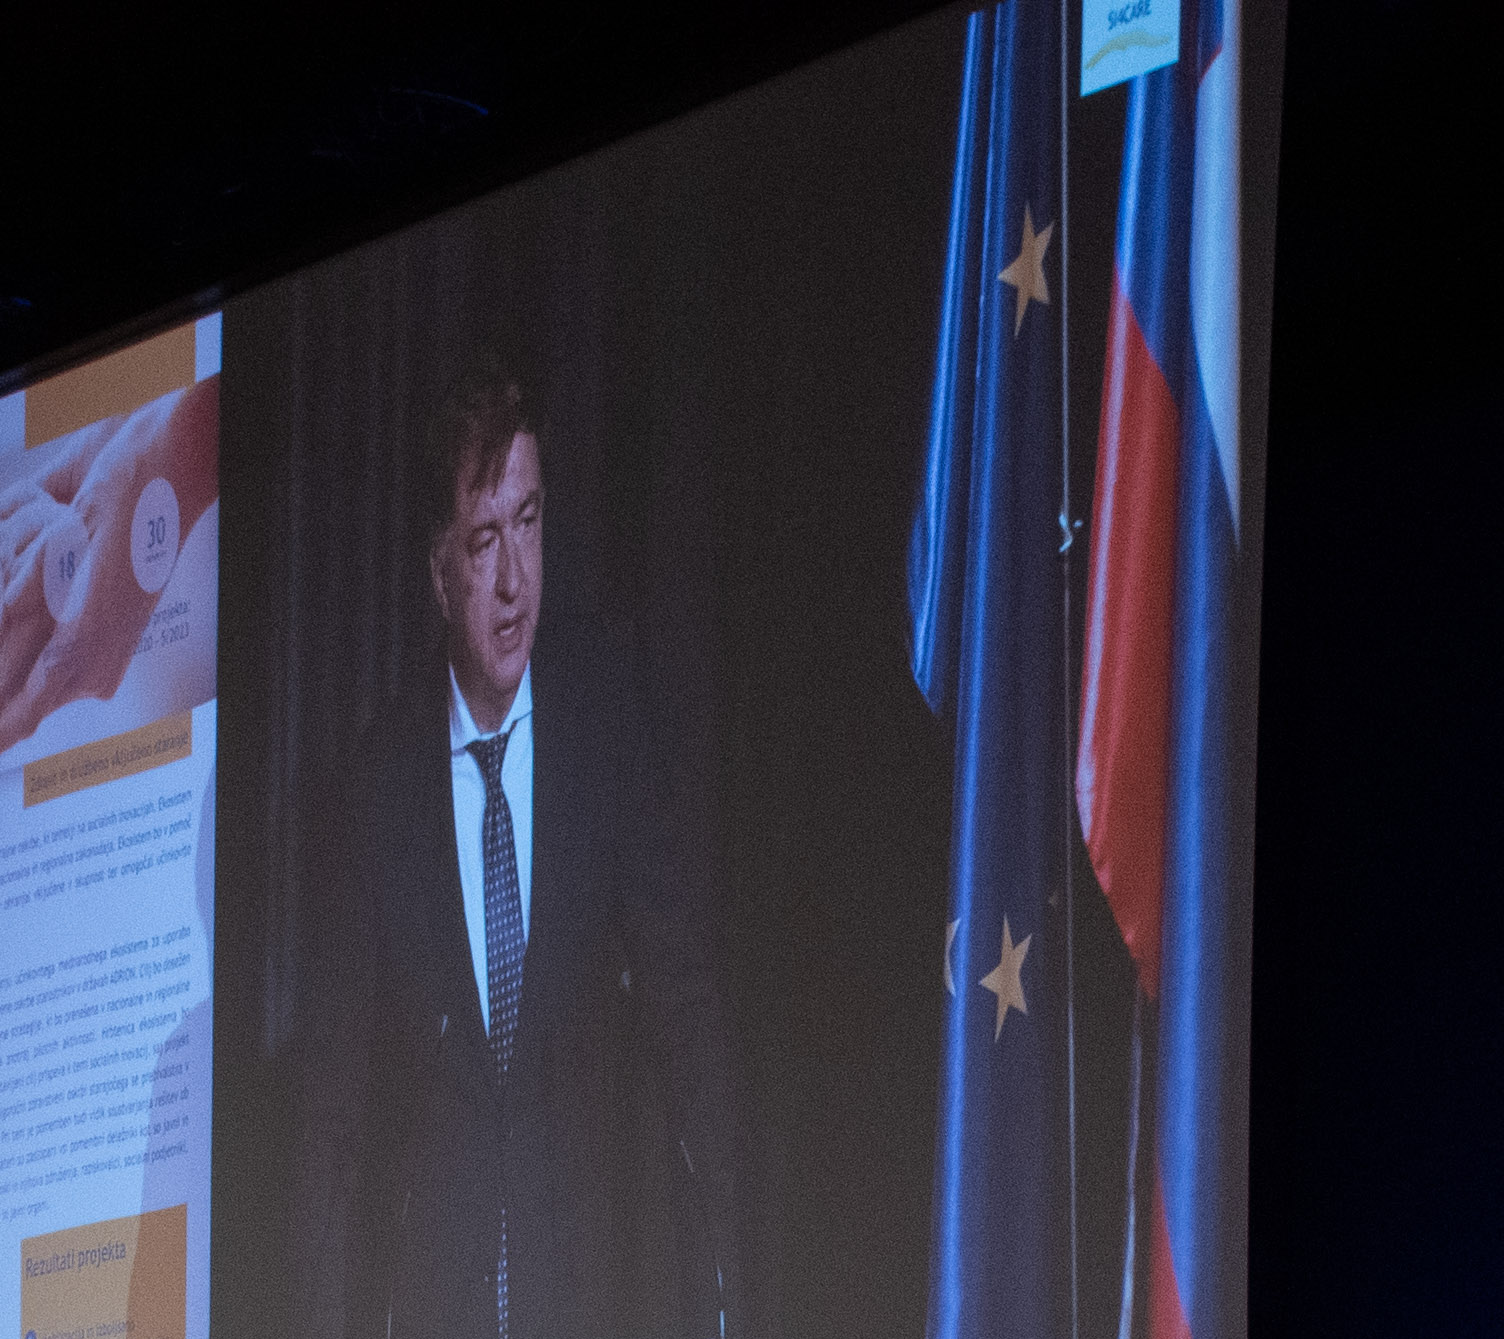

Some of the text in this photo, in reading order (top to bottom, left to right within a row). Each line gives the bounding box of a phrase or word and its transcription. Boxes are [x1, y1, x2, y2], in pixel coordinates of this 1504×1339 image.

[147, 516, 167, 549] 30
[59, 550, 75, 581] 18
[25, 1242, 126, 1280] Rezultati projekta
